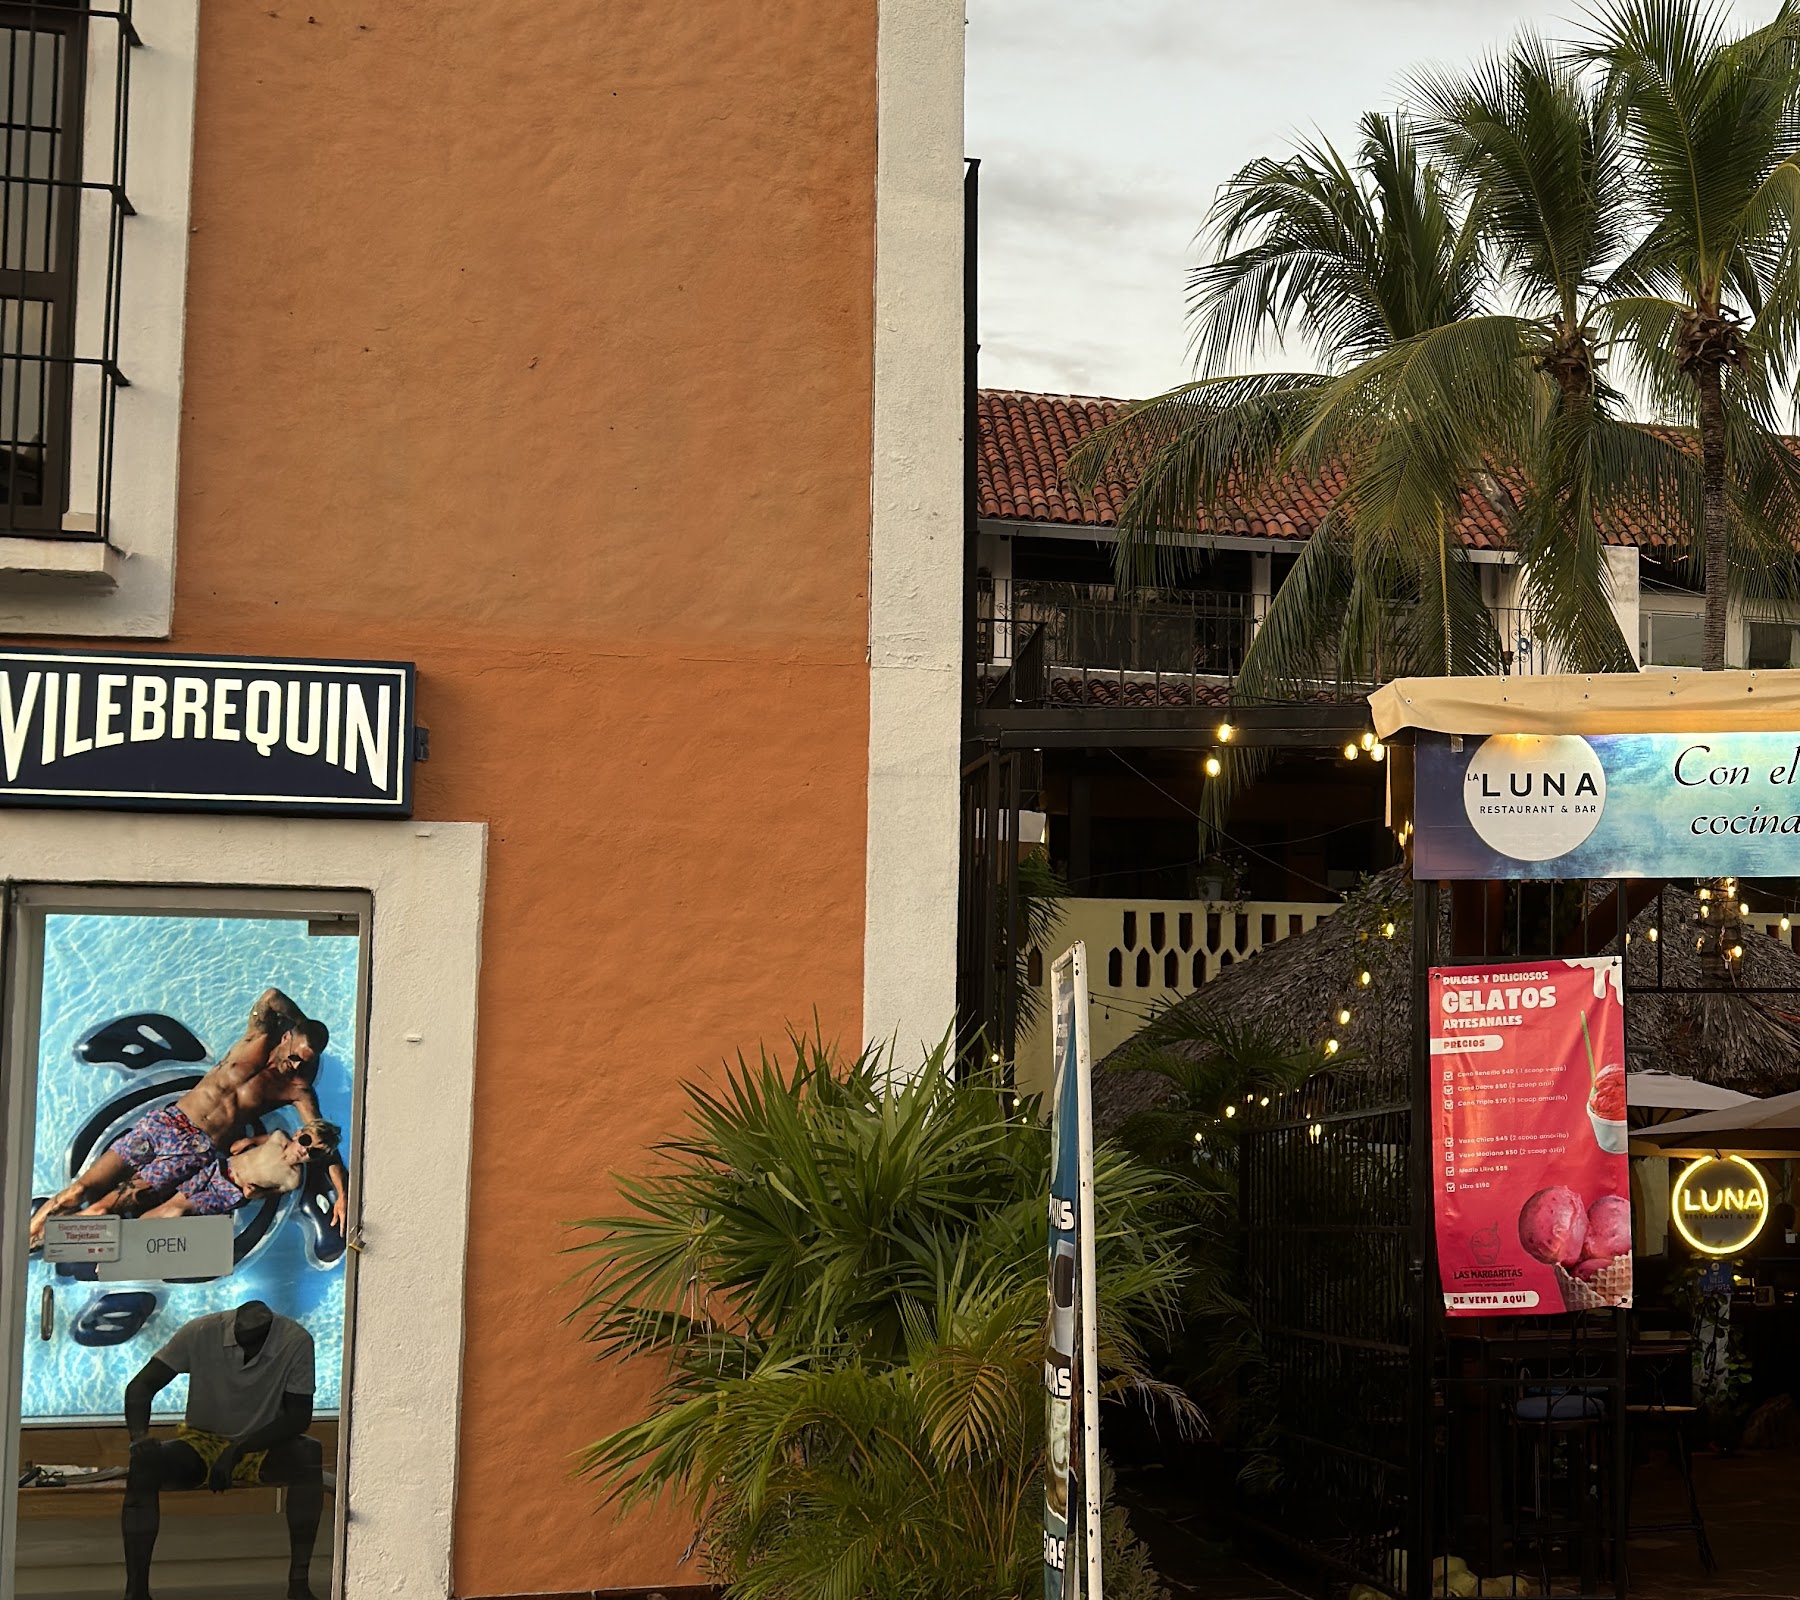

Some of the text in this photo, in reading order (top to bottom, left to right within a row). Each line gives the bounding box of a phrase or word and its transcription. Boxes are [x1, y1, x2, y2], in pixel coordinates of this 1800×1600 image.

[0, 671, 391, 792] VILEBREQUIN
[1674, 745, 1750, 787] Con
[1467, 773, 1599, 797] LA LUNA
[1480, 805, 1596, 814] RESTAURANT & BAR
[1443, 971, 1549, 985] DULCES Y DELICIOSOS
[1442, 986, 1557, 1014] GELATOS
[1443, 1015, 1523, 1030] ARTESANALES
[1444, 1040, 1485, 1049] PRECIOS
[1684, 1188, 1763, 1212] LUNA
[146, 1238, 187, 1254] OPEN
[1453, 1268, 1523, 1279] LAS MARGARITAS
[1453, 1293, 1526, 1304] DE VENTA AQUÍ
